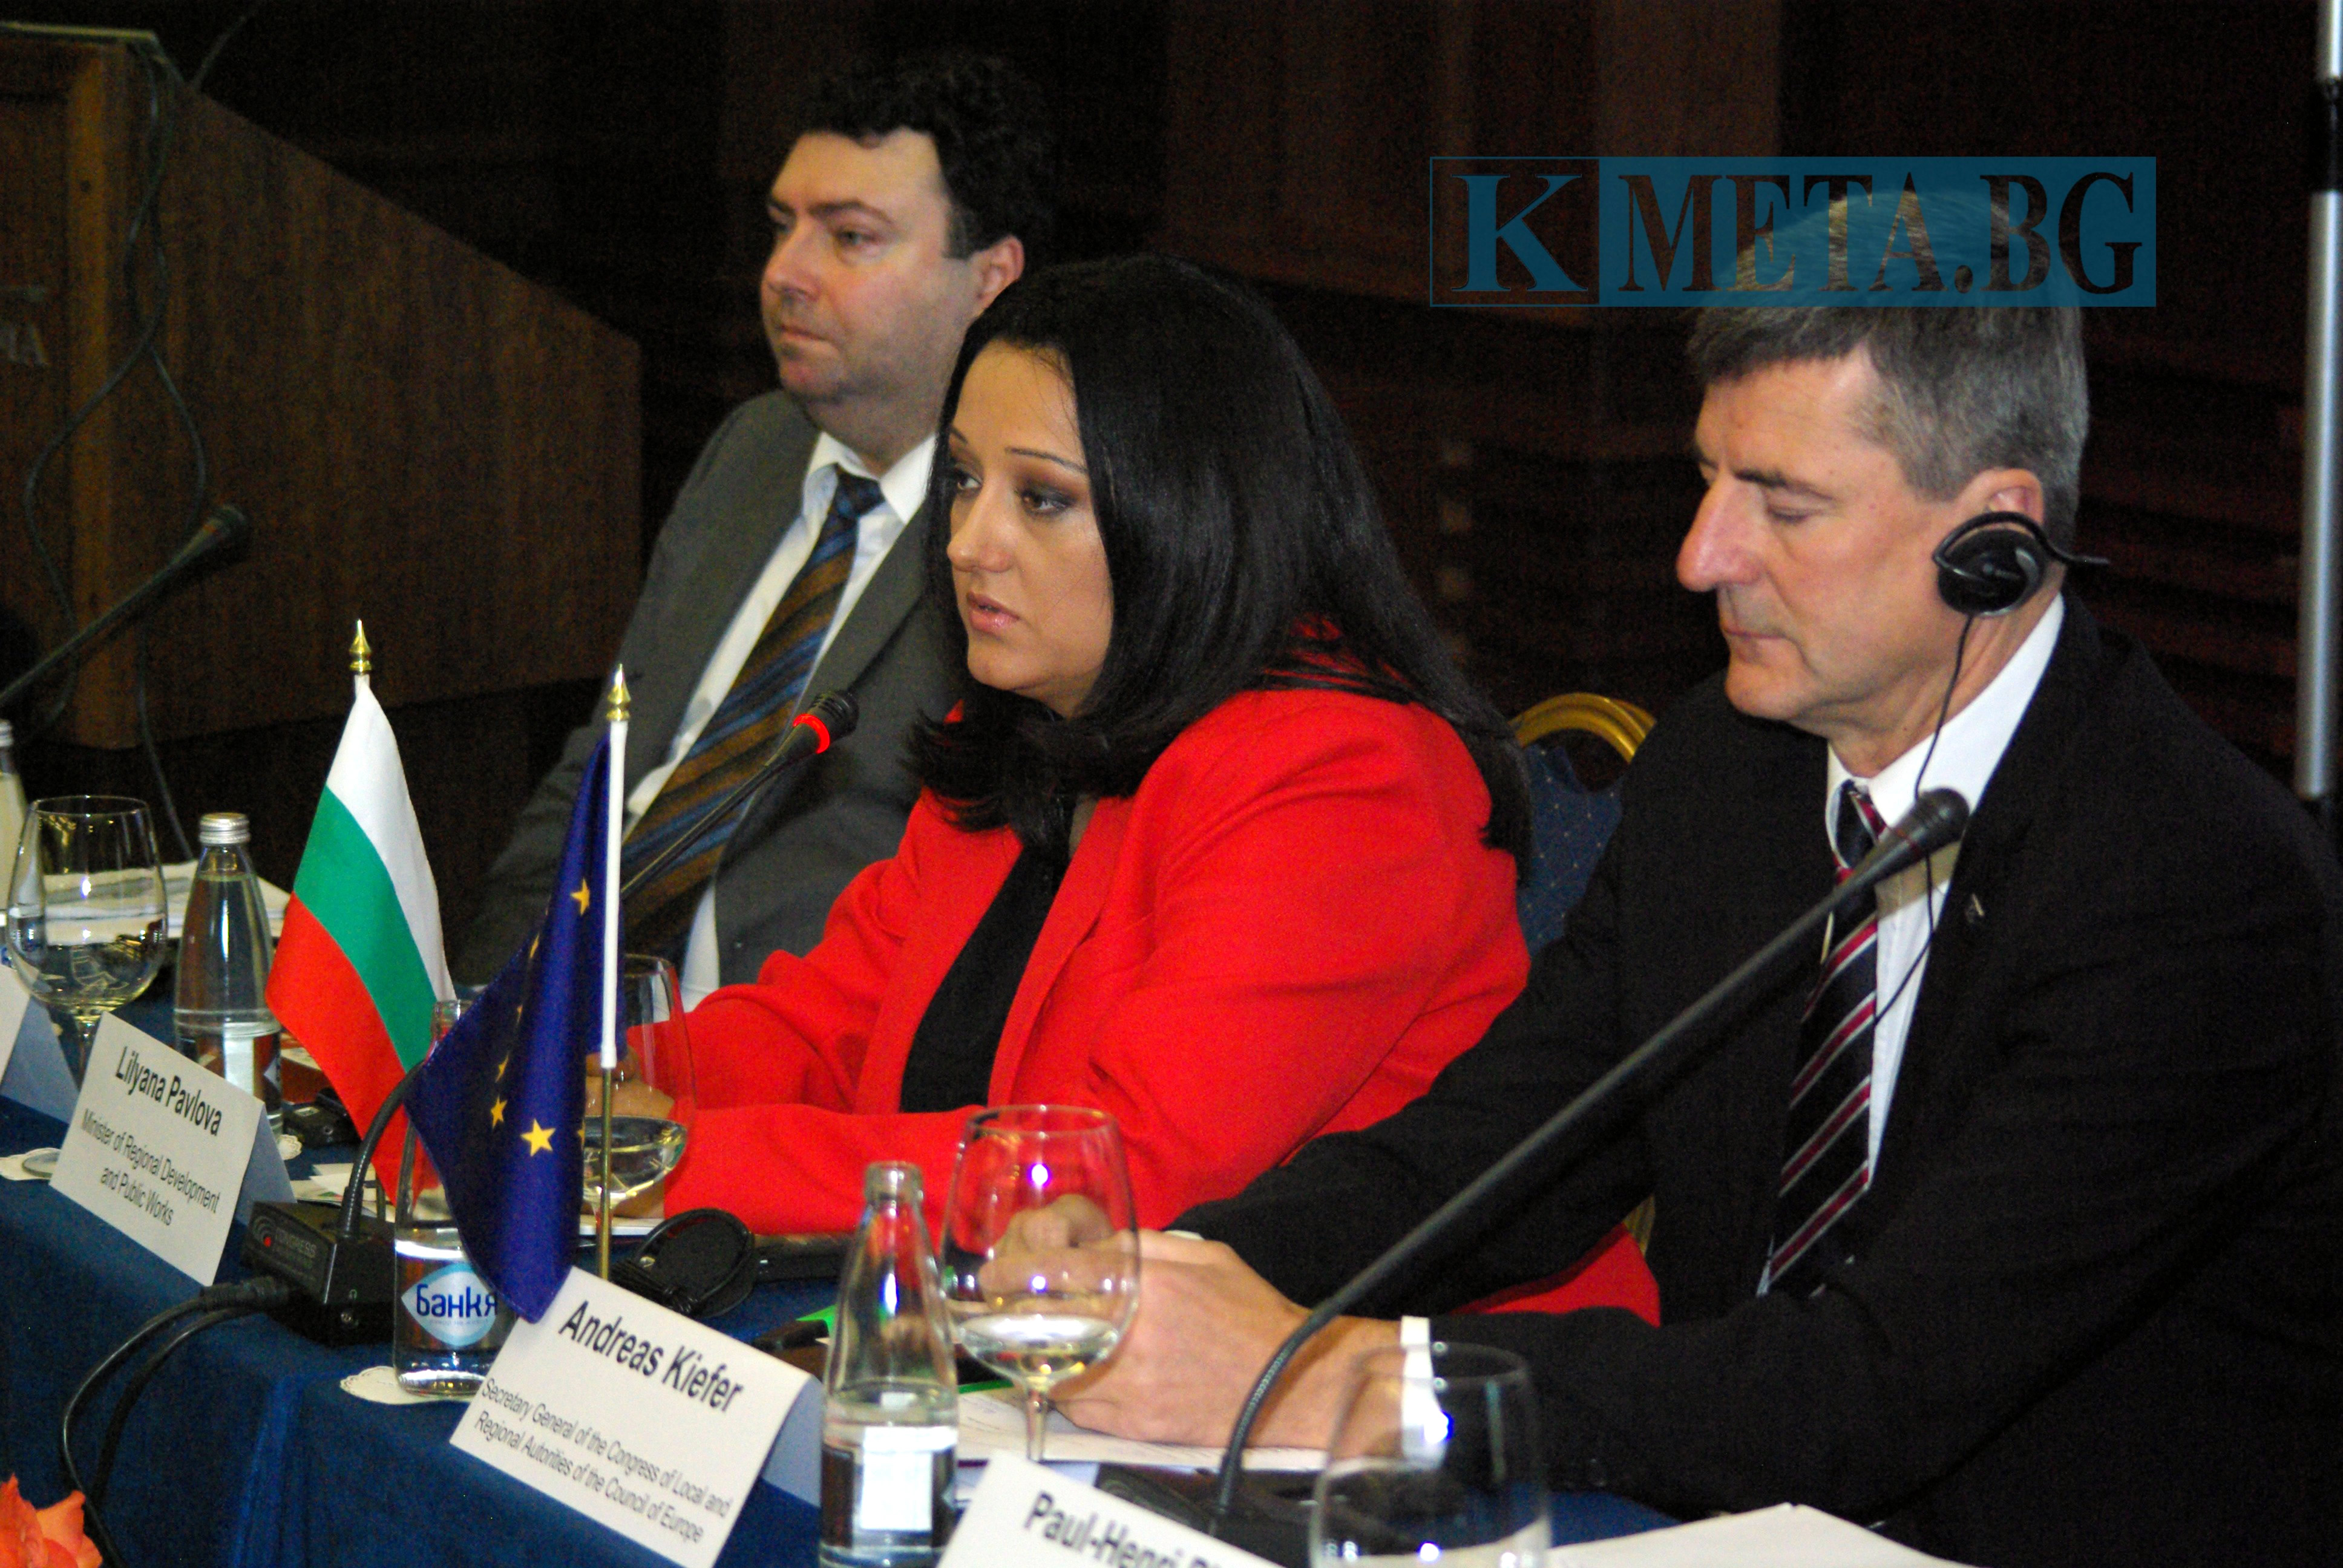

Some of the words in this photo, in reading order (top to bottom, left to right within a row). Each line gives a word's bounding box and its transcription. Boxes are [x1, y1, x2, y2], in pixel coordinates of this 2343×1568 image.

[115, 1045, 167, 1103] Lilyana
[165, 1075, 223, 1137] Pavlova
[80, 1108, 116, 1146] Minister
[113, 1131, 128, 1151] of
[122, 1134, 164, 1177] Regional
[159, 1157, 221, 1214] Development
[99, 1167, 121, 1191] and
[118, 1172, 146, 1208] Public
[145, 1189, 175, 1226] Works
[557, 1299, 665, 1377] Andreas
[661, 1345, 744, 1413] Kiefer
[474, 1410, 526, 1450] Regional
[571, 1462, 591, 1482] of
[584, 1468, 605, 1492] the
[605, 1476, 650, 1514] Council
[647, 1501, 666, 1521] of
[660, 1504, 704, 1544] Europe
[481, 1377, 534, 1422] Secretary
[532, 1402, 579, 1439] General
[574, 1426, 594, 1446] of
[586, 1431, 608, 1456] the
[606, 1439, 660, 1482] Congress
[658, 1468, 678, 1488] of
[671, 1472, 710, 1504] Local
[704, 1493, 734, 1519] and
